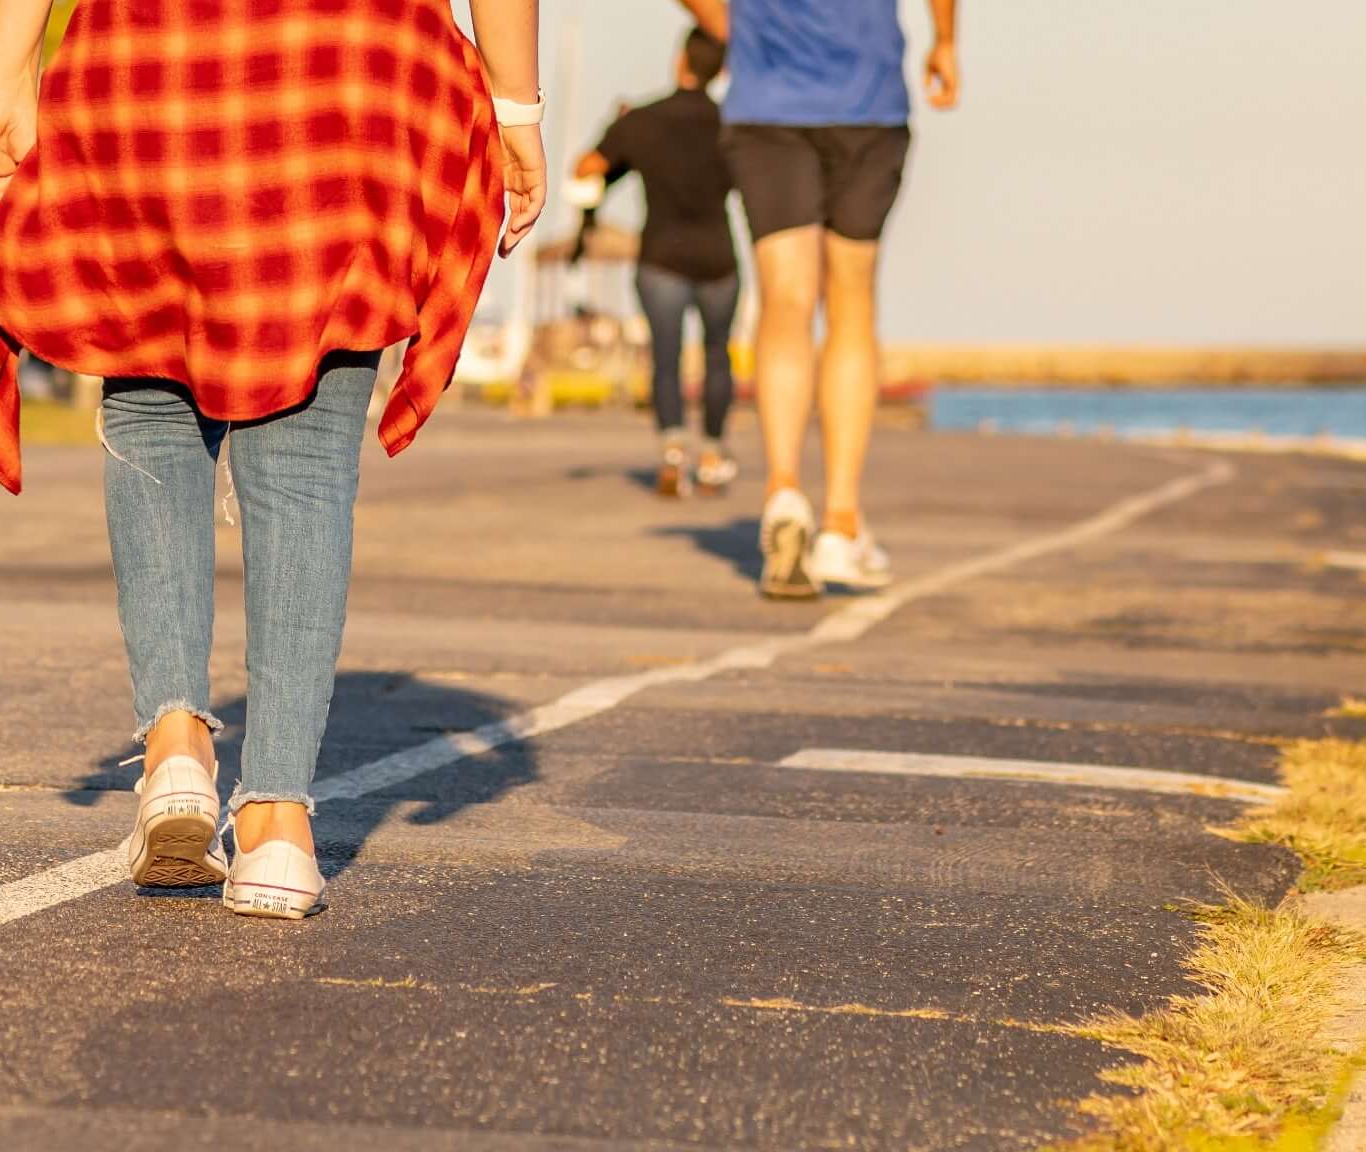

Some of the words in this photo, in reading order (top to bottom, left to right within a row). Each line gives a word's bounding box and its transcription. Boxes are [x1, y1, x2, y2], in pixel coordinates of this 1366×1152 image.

[167, 805, 177, 816] ALL
[186, 804, 201, 816] STAR
[254, 892, 288, 902] CONVERSE
[252, 898, 262, 909] ALL
[271, 901, 287, 914] STAR
